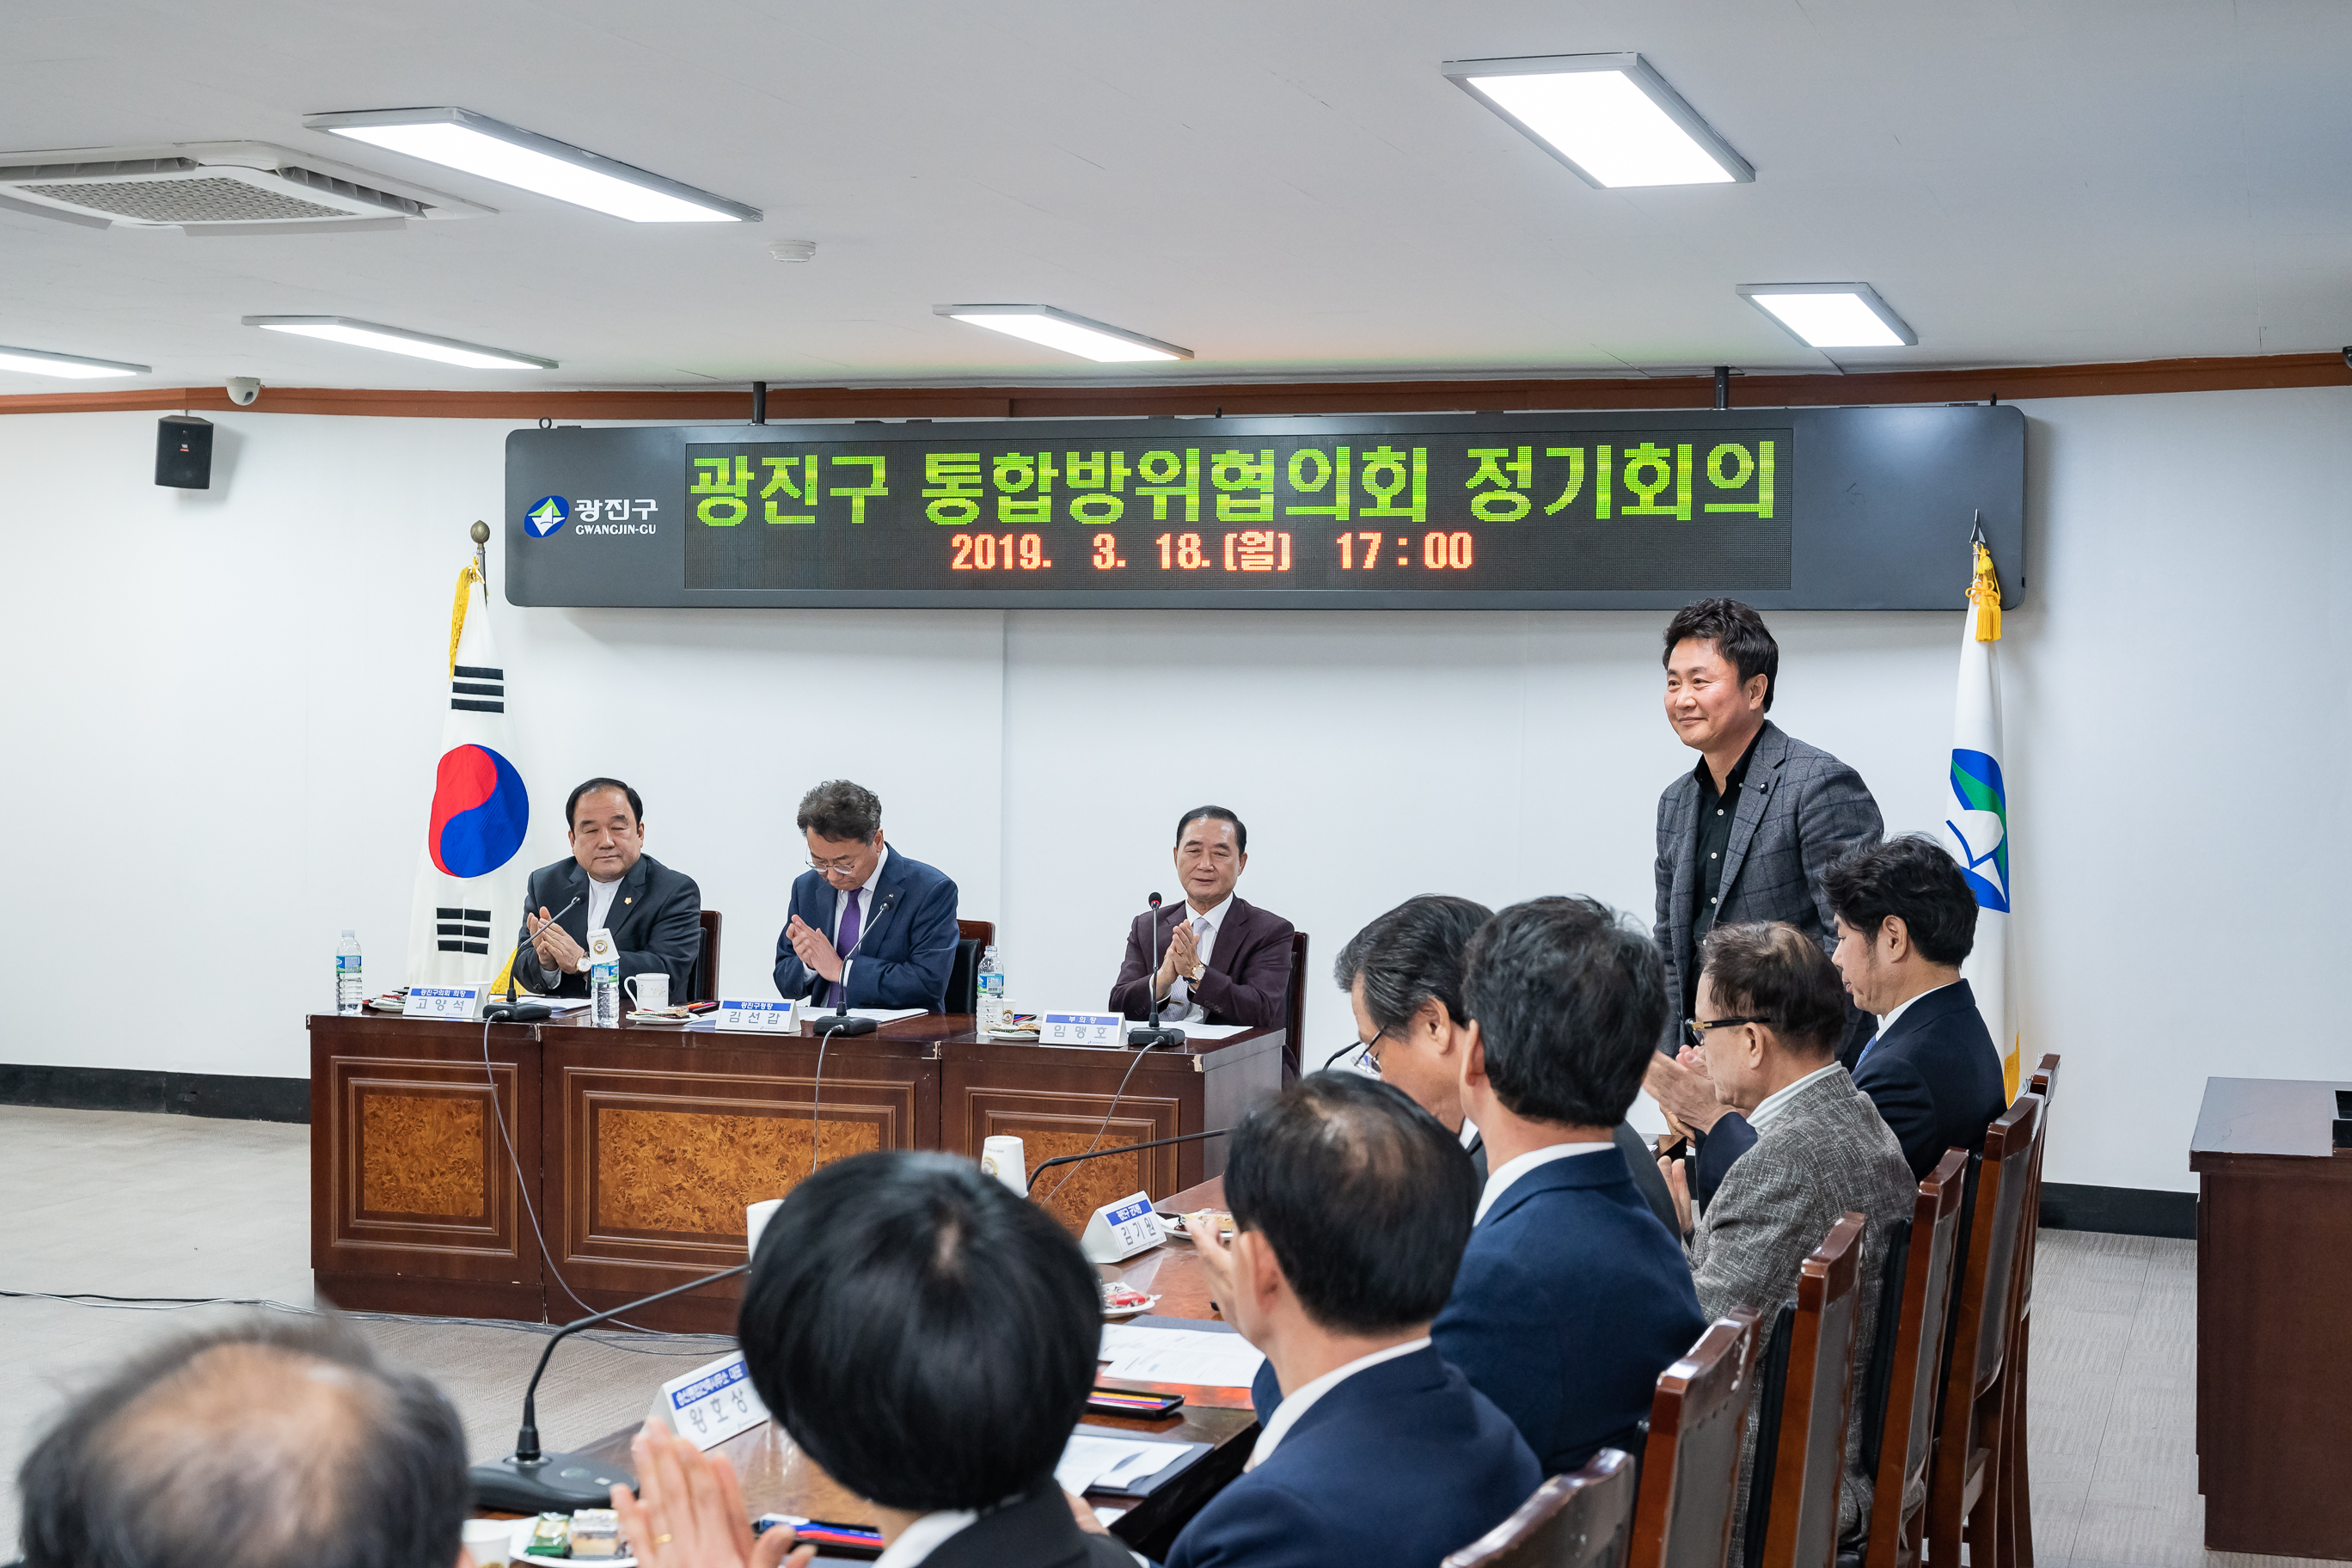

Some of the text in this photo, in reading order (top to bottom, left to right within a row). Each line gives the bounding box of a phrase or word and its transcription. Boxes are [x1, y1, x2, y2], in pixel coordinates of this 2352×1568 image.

[690, 441, 1774, 526] 광진구 통합방위협의회 정기회의
[574, 499, 658, 522] 광진구
[575, 524, 657, 535] GWANGJIN-GU
[952, 533, 1051, 570] 2019.
[1093, 532, 1126, 570] 3.
[740, 1001, 774, 1010] 광진구청장
